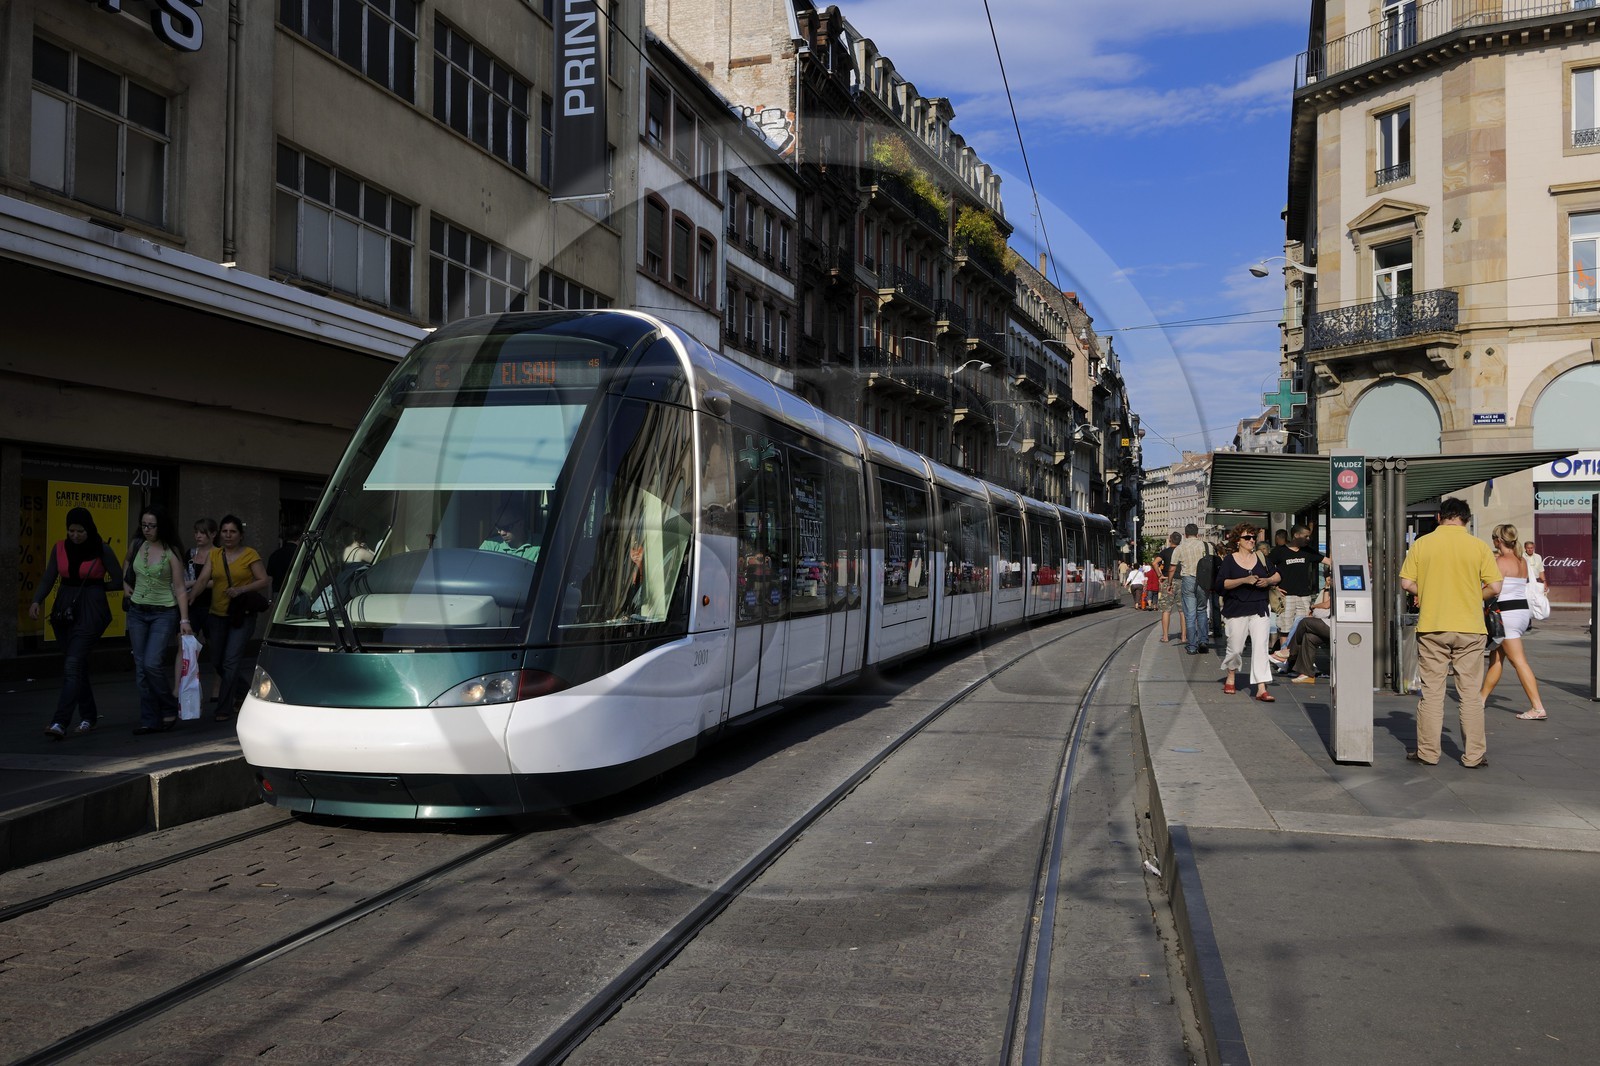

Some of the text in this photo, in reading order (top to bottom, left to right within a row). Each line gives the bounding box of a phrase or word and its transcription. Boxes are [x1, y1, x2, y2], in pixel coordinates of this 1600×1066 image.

[502, 360, 555, 385] ELSAU
[131, 469, 160, 488] 20H
[20, 496, 43, 511] ES
[56, 491, 121, 503] CARTE PRINTEMPS
[1542, 555, 1586, 568] Cartier
